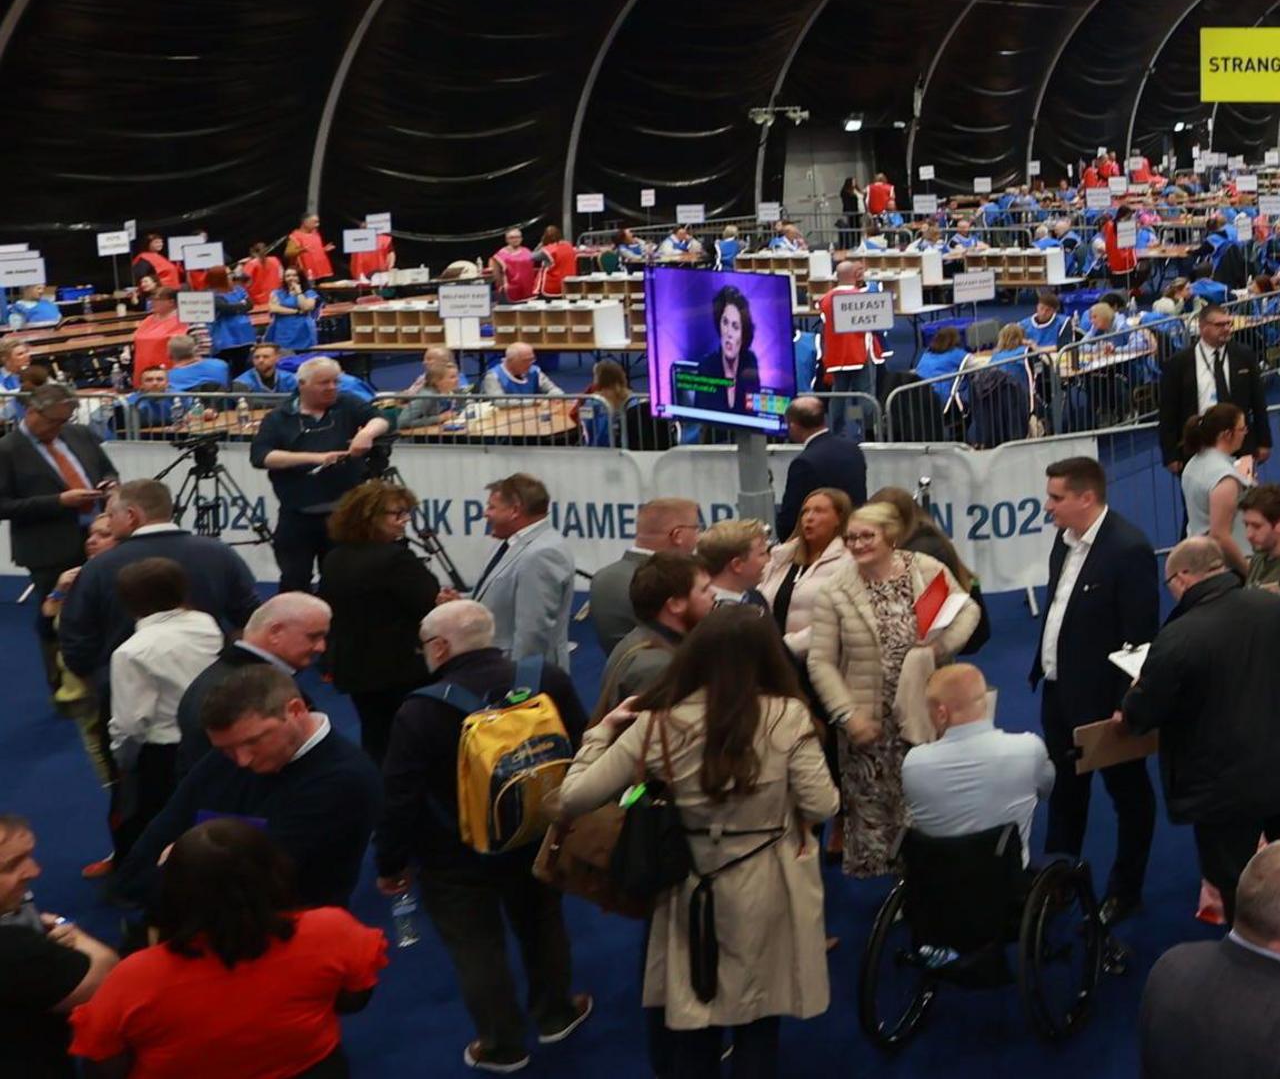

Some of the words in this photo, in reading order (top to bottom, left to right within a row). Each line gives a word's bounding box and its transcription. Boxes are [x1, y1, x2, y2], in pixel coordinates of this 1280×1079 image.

[840, 300, 885, 312] BELFAST
[851, 315, 877, 325] EAST
[966, 497, 1056, 541] 202
